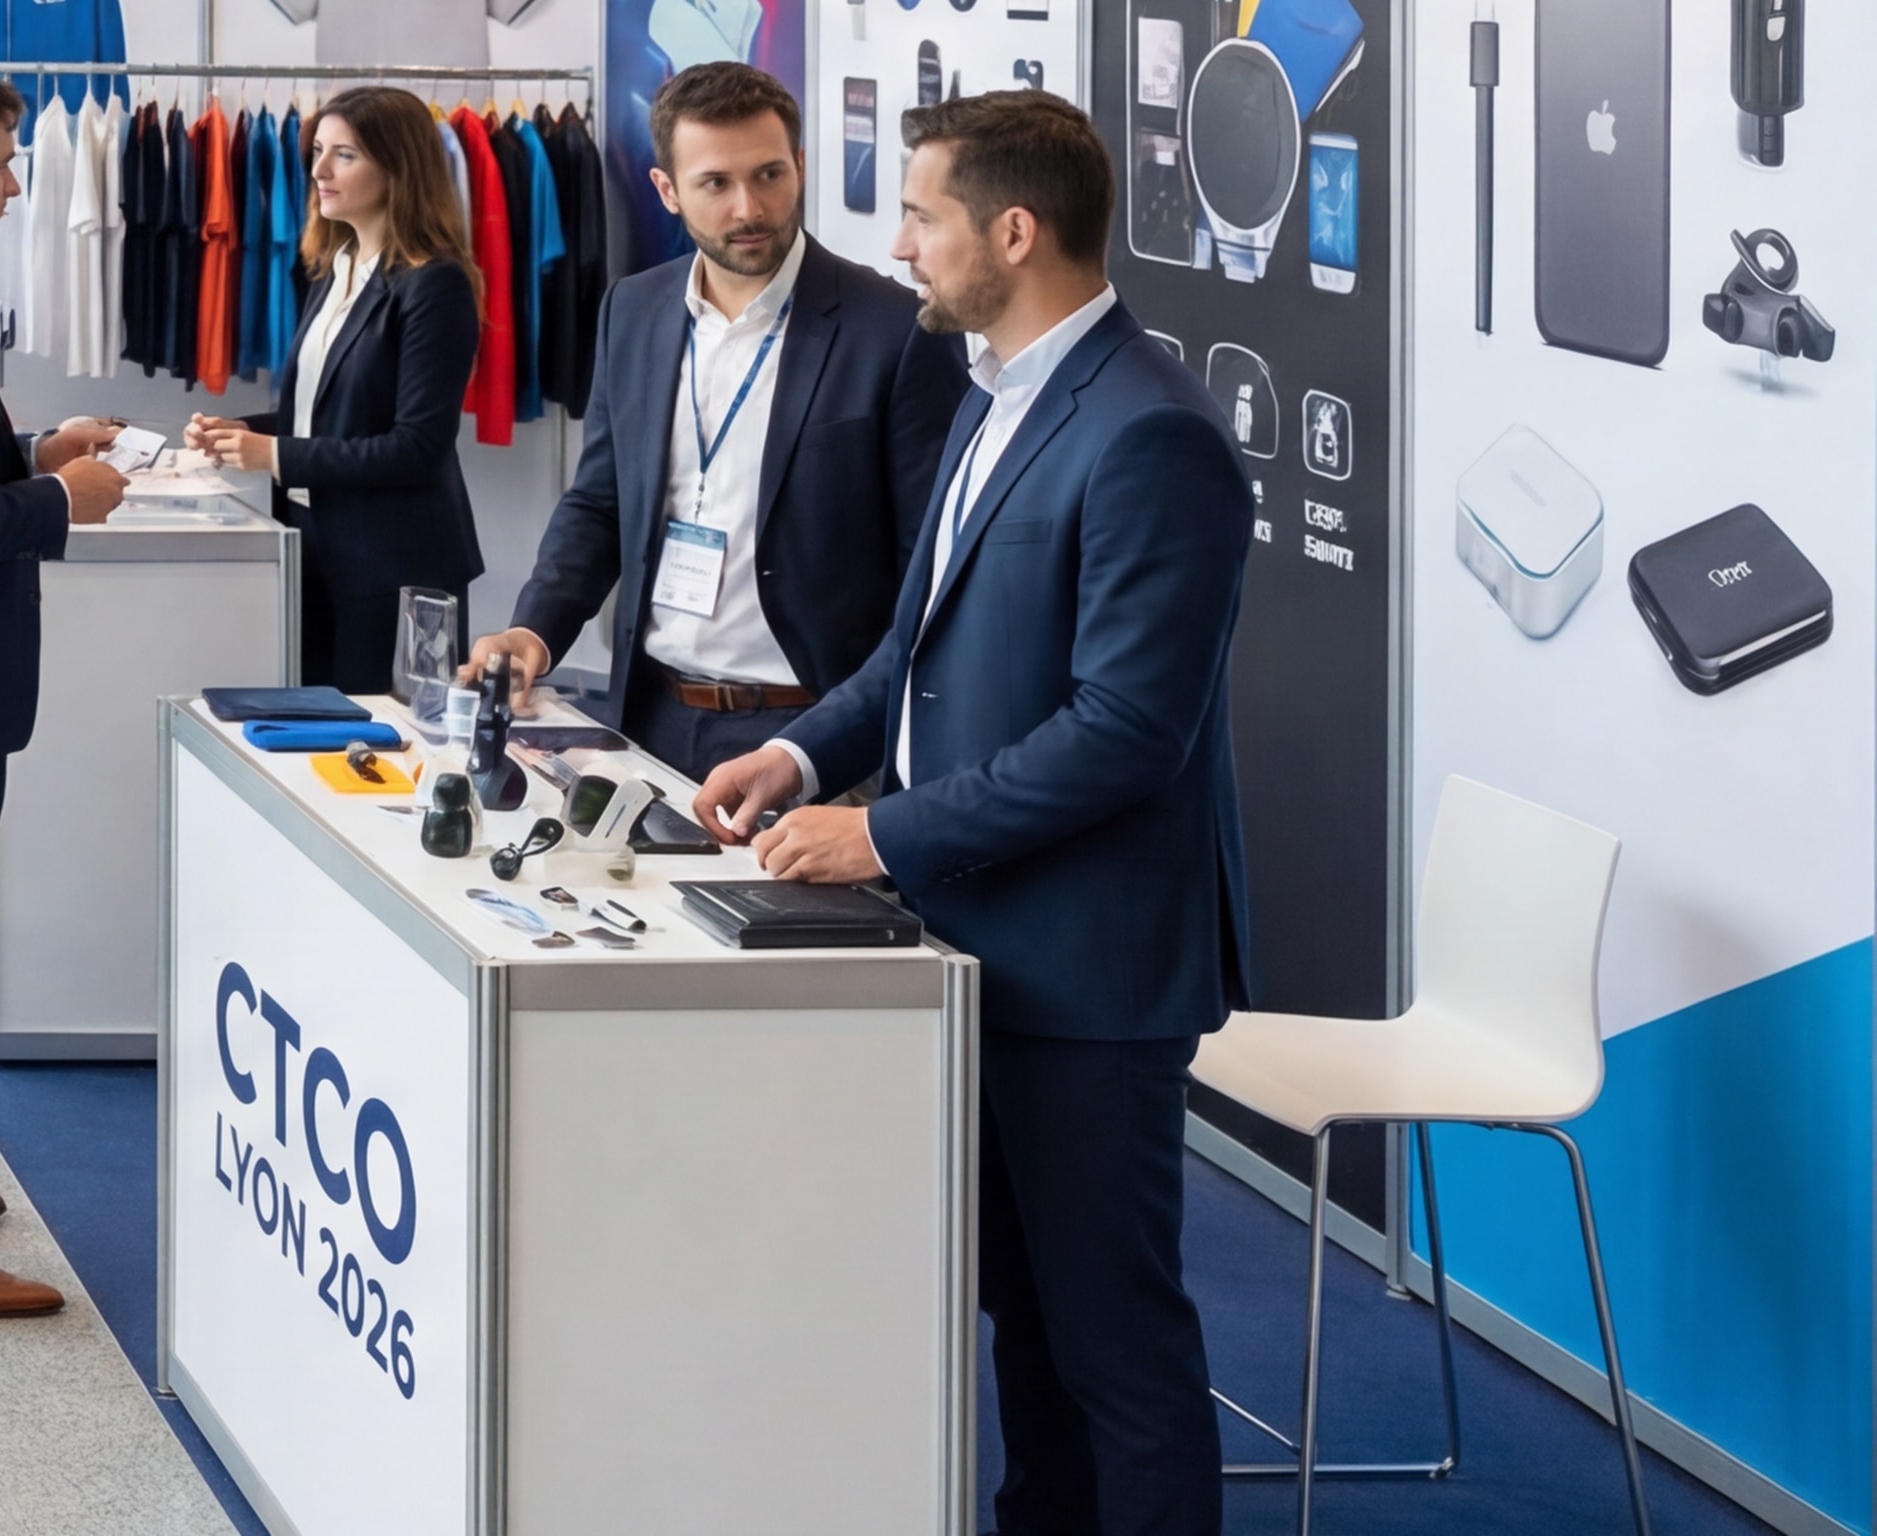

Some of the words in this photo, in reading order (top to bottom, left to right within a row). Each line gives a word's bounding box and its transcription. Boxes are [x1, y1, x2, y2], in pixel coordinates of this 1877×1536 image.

[215, 961, 417, 1265] CTCO
[215, 1111, 307, 1277] LYON
[317, 1227, 415, 1401] 2026
